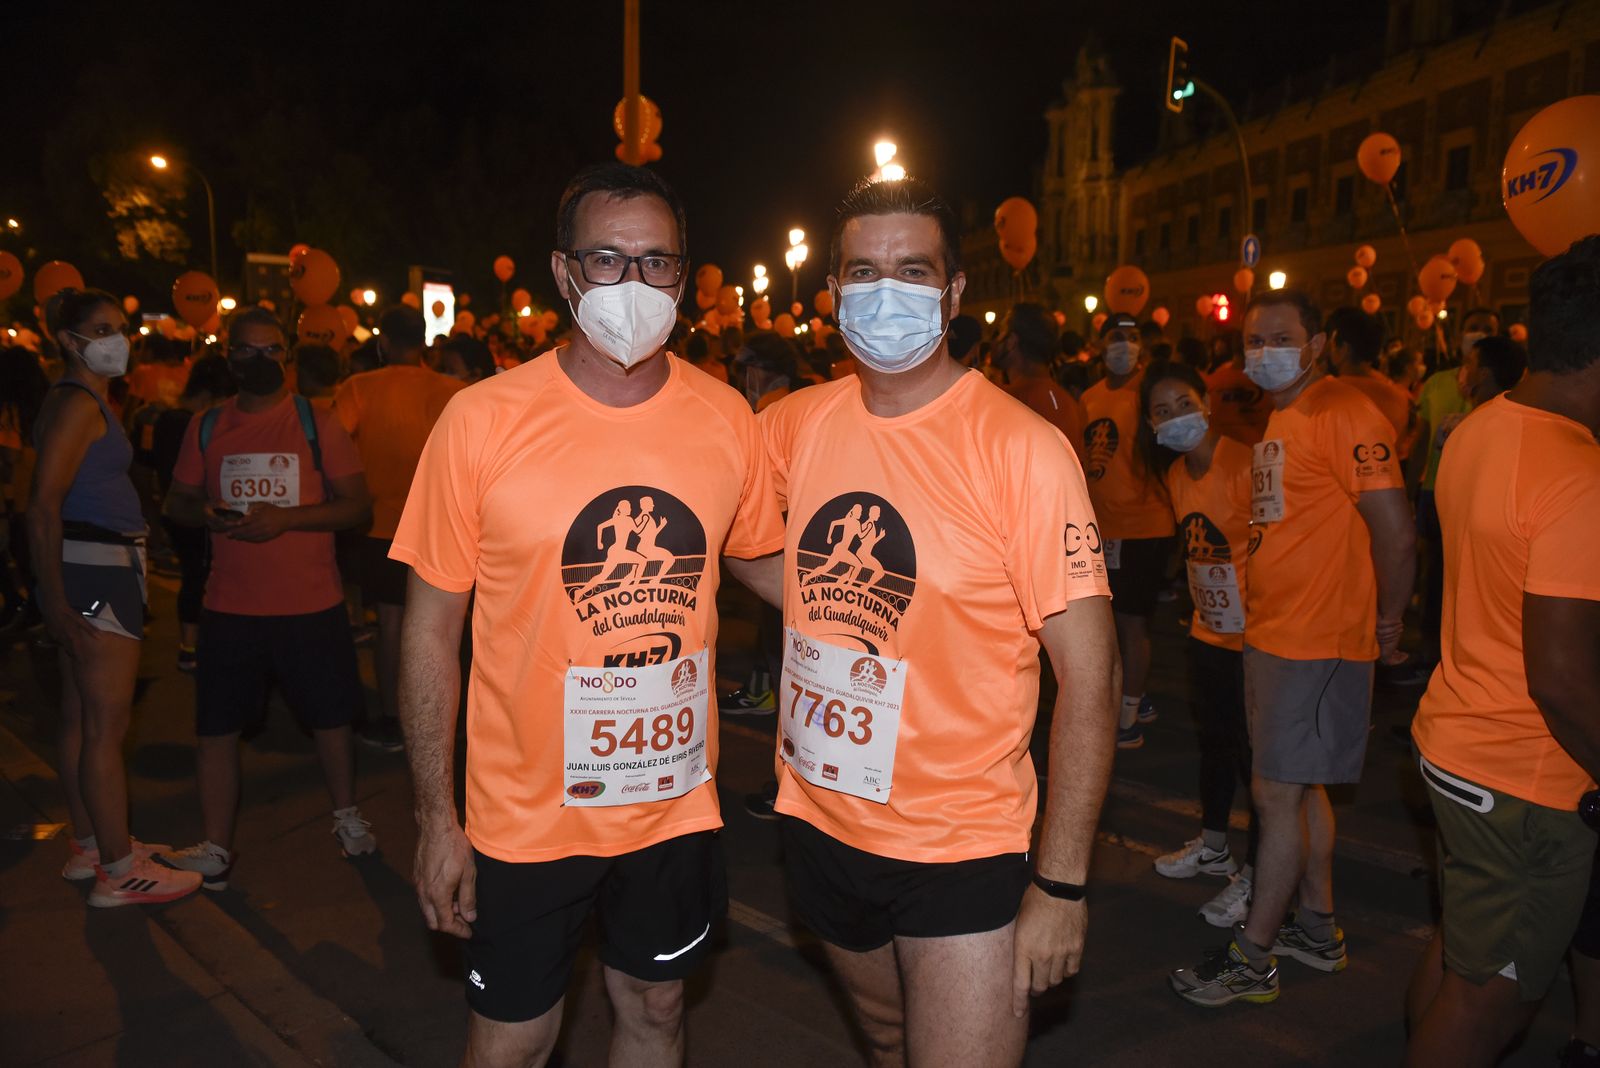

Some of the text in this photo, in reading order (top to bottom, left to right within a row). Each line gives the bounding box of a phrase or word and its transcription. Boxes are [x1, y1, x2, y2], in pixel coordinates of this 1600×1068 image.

[231, 478, 287, 498] 6305
[1071, 560, 1087, 569] IMD
[576, 588, 697, 622] LA NOCTURNA
[801, 587, 899, 632] LA NOCTURNA
[592, 608, 686, 636] del Guadalquivir
[808, 606, 889, 642] del Guadalquivir
[835, 690, 874, 704] GUADALQUIVIR
[790, 681, 873, 745] 7763
[590, 707, 695, 757] 5489
[566, 763, 590, 771] JUAN
[592, 763, 611, 771] LUIS
[613, 758, 657, 771] GONZÁLEZ
[672, 750, 687, 763] EIRIS
[863, 775, 881, 785] ABC
